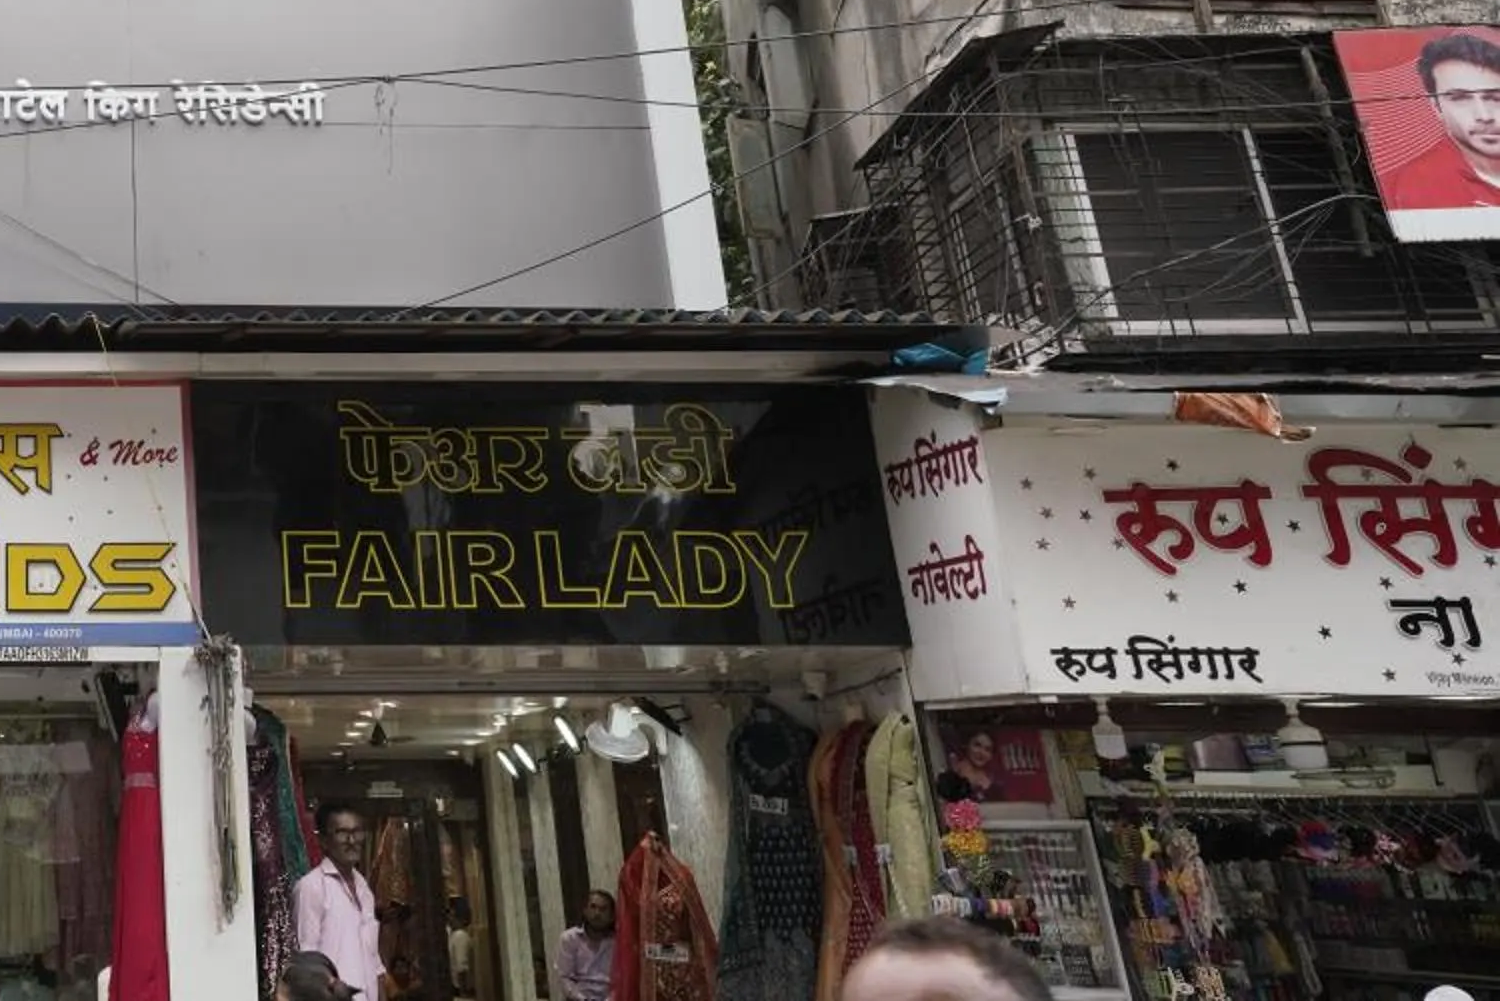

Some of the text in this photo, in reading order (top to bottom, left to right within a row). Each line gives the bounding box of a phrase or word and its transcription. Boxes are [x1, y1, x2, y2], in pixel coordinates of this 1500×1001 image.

[80, 436, 178, 466] & More
[281, 531, 526, 609] FAIR
[534, 531, 809, 610] LADY
